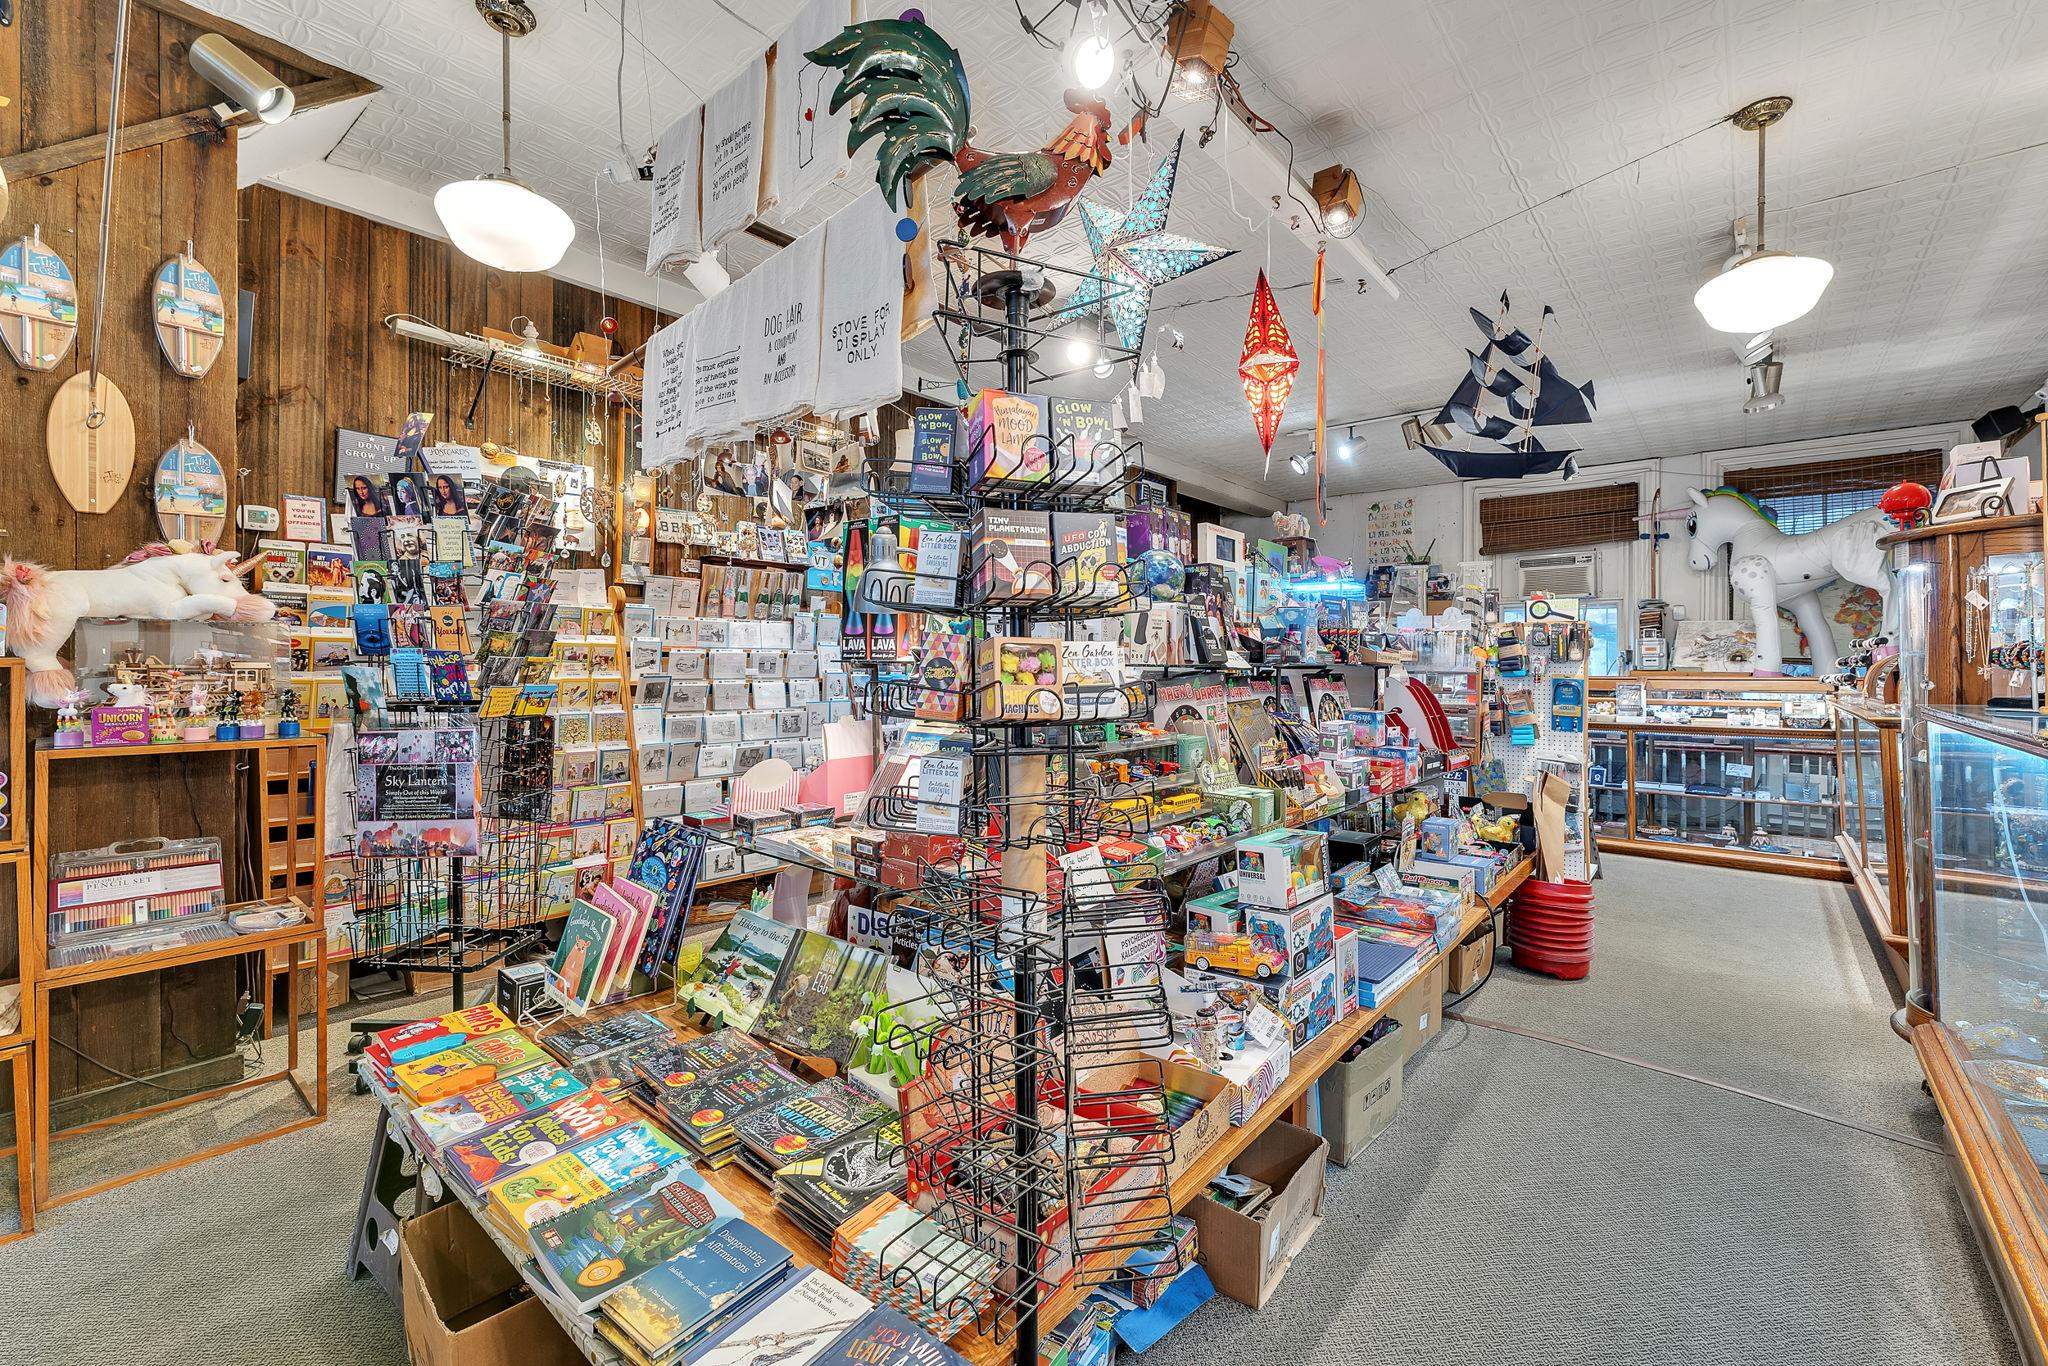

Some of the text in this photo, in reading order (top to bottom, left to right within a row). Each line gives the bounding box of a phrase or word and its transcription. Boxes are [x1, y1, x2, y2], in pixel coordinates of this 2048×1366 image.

[36, 255, 60, 270] TIKI
[190, 272, 210, 285] TIKI
[764, 313, 783, 338] DOG
[832, 315, 868, 339] STOVE
[836, 321, 887, 352] DISPLAY
[847, 343, 880, 364] ONLY.
[1056, 401, 1092, 414] GLOW
[918, 413, 944, 422] GLOW
[998, 416, 1033, 431] MOOD
[1075, 415, 1112, 431] BOWL
[930, 422, 954, 432] BOWL
[357, 441, 386, 452] DONT
[922, 437, 942, 446] GLOW
[190, 455, 211, 467] TIKI
[345, 449, 376, 461] GROW
[922, 452, 944, 463] BOWL
[988, 516, 1009, 525] TINY
[988, 524, 1046, 535] PLANETARIUM
[1064, 528, 1108, 543] UFO COW
[1060, 538, 1112, 555] ABDUCTION
[843, 638, 866, 650] LAVA
[871, 638, 896, 650] LAVA
[1062, 644, 1114, 659] Zen Garden
[1093, 658, 1114, 667] BOX
[1195, 684, 1224, 700] DARTS
[98, 713, 144, 724] UNICORN
[922, 768, 944, 776] LITTER
[936, 760, 960, 770] Garden
[385, 774, 448, 788] Sky Lantern
[86, 876, 153, 891] PENCIL SET
[1238, 870, 1266, 881] UNIVERSAL
[737, 917, 762, 938] Hiking
[760, 928, 770, 937] to
[768, 930, 782, 943] the
[894, 937, 918, 950] Articles
[1121, 937, 1157, 961] KALEIDOSCOPE
[812, 972, 833, 996] EGG
[535, 1064, 553, 1081] The
[484, 1085, 523, 1118] Useless
[786, 1097, 854, 1134] EXTREME
[480, 1132, 518, 1164] Kids
[599, 1138, 624, 1160] You
[616, 1129, 662, 1164] Would
[578, 1146, 630, 1186] Rather?
[670, 1182, 714, 1224] CABIN FEVER
[670, 1196, 686, 1215] SEARCH
[718, 1228, 767, 1268] Disappointing
[705, 1240, 750, 1275] Affirmations
[802, 1282, 832, 1304] Dumb Birds
[810, 1276, 820, 1286] The
[820, 1282, 832, 1295] Field
[830, 1290, 848, 1304] Guide
[800, 1288, 816, 1305] North
[816, 1301, 838, 1318] America
[870, 1324, 908, 1348] YOU
[846, 1338, 897, 1366] LEAVE
